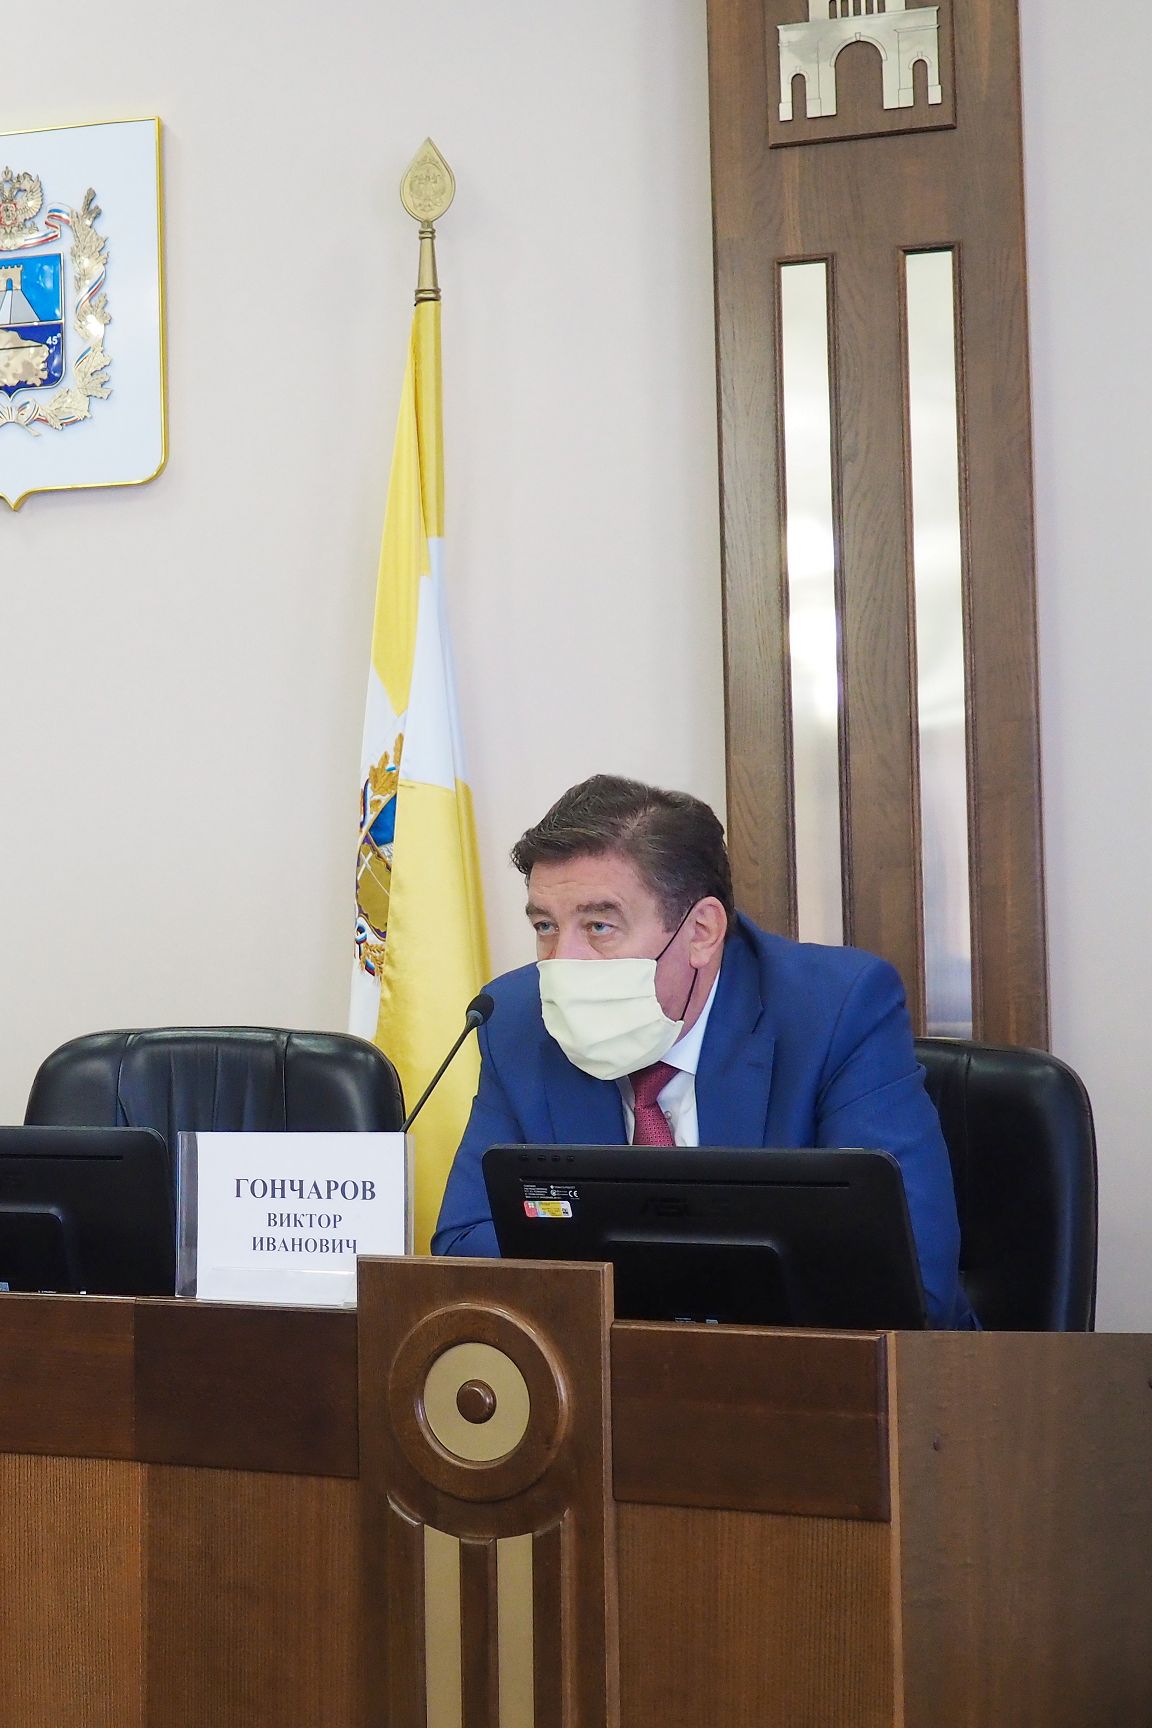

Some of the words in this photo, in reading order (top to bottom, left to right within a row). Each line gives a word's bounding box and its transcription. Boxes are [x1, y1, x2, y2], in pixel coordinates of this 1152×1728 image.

[234, 1178, 376, 1201] ГОНЧАРОВ
[267, 1212, 343, 1229] ВИКТОР
[251, 1236, 358, 1254] ИВАНОВИЧ
